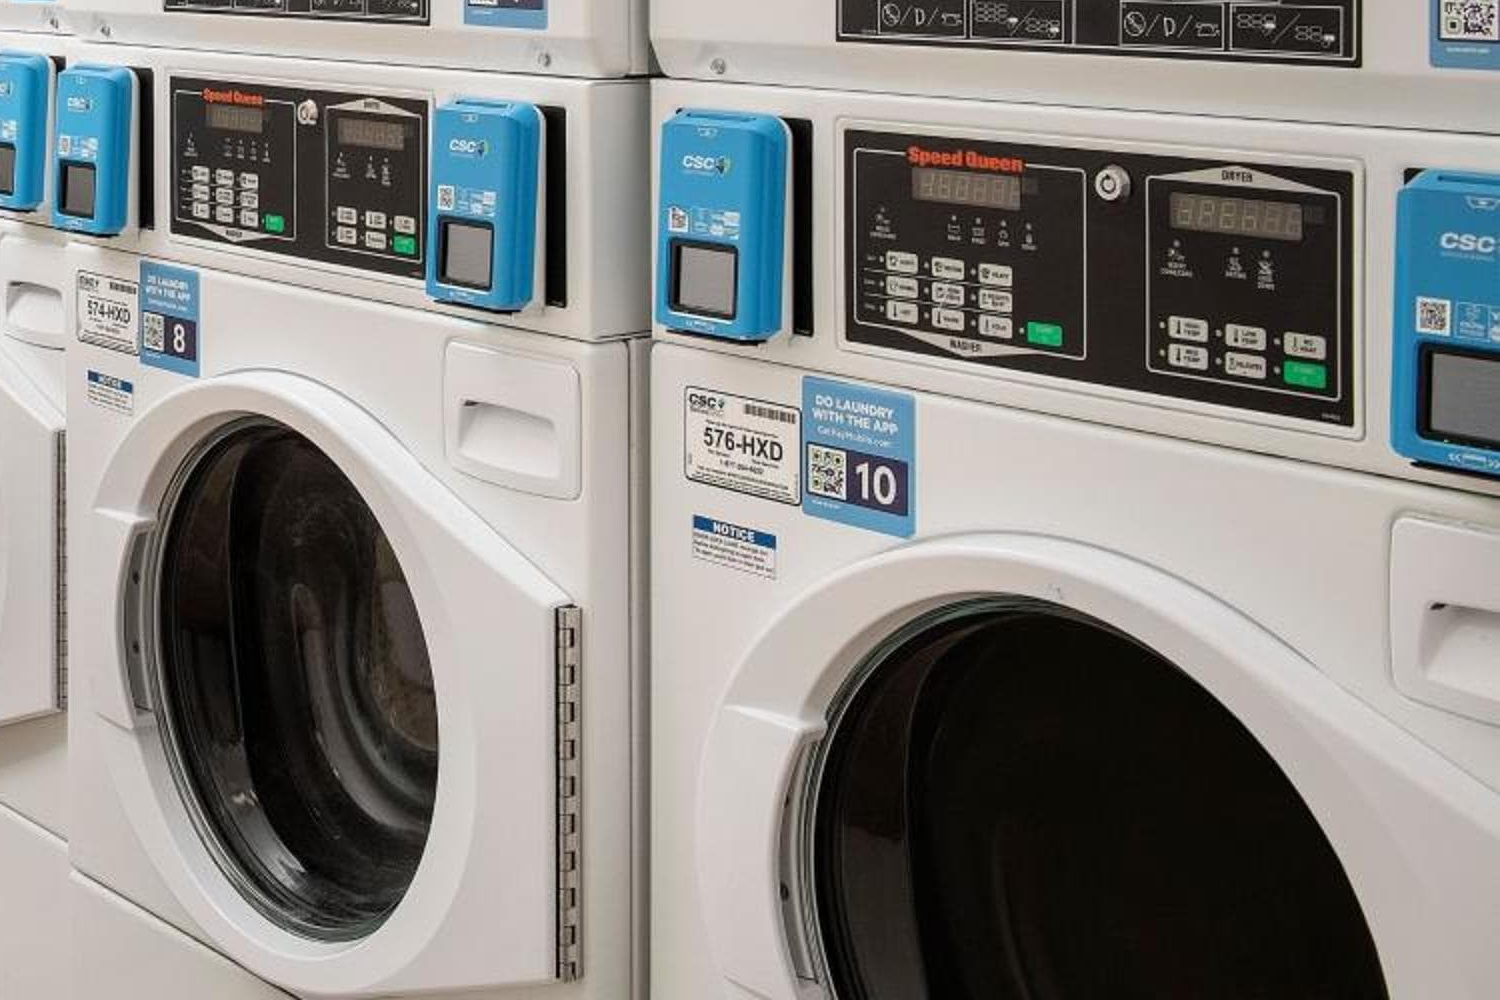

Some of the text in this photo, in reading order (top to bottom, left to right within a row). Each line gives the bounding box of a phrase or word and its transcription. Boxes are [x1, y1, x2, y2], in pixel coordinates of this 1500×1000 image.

[449, 139, 477, 153] CSC
[683, 155, 715, 169] CSC
[907, 146, 1022, 173] Speed Queen
[1440, 231, 1496, 253] CSC
[87, 300, 131, 324] 574-HXD
[173, 323, 186, 353] 8
[689, 393, 717, 409] CSC
[815, 394, 895, 420] DO LAUNDRY
[812, 407, 899, 436] WITH THE APP
[703, 427, 784, 462] 576-HXD
[855, 461, 897, 506] 10
[712, 521, 756, 543] NOTICE
